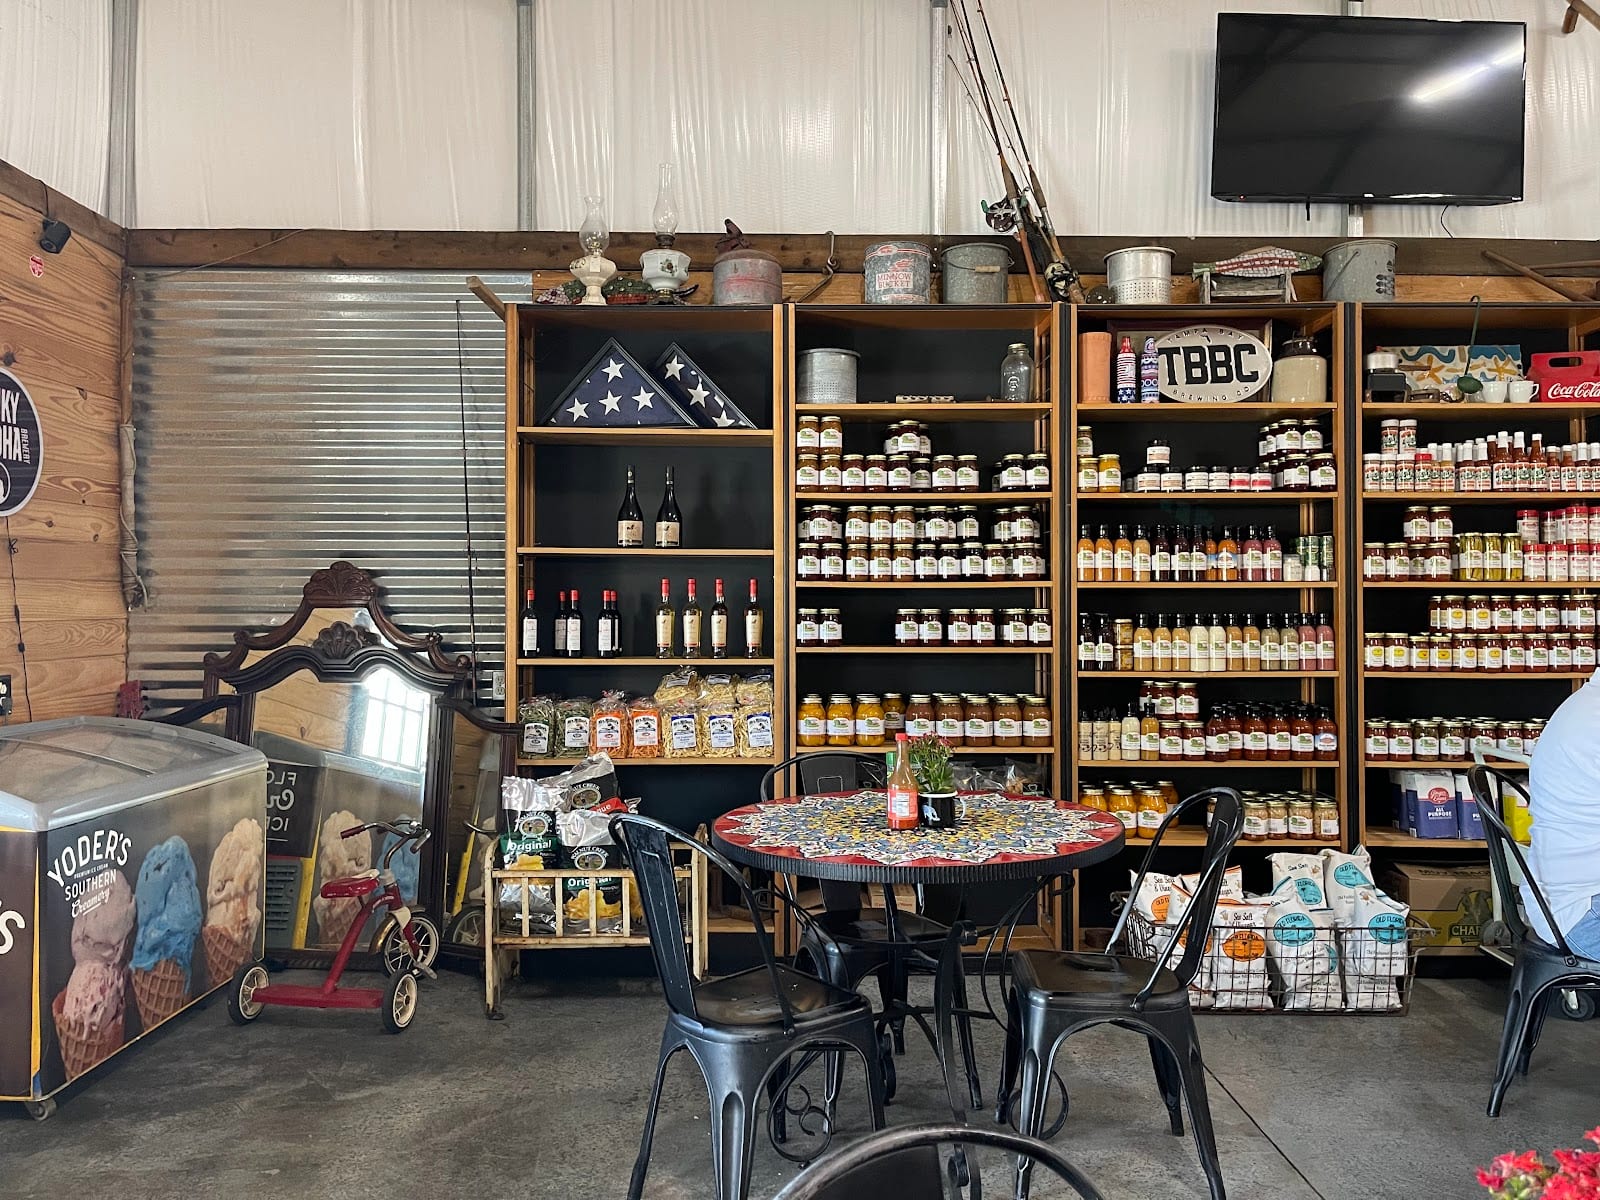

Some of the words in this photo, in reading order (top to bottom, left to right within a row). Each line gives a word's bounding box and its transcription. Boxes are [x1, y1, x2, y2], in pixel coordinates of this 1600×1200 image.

[1167, 328, 1207, 344] TAMPA
[1219, 328, 1245, 341] BAY
[1158, 344, 1260, 386] TBBC
[1172, 389, 1228, 402] BREWING
[0, 425, 22, 461] HA
[20, 428, 31, 465] BREWERY
[47, 830, 132, 887] YODER'S
[509, 840, 552, 853] Original
[65, 869, 117, 901] SOUTHERN
[72, 888, 110, 918] Creamery
